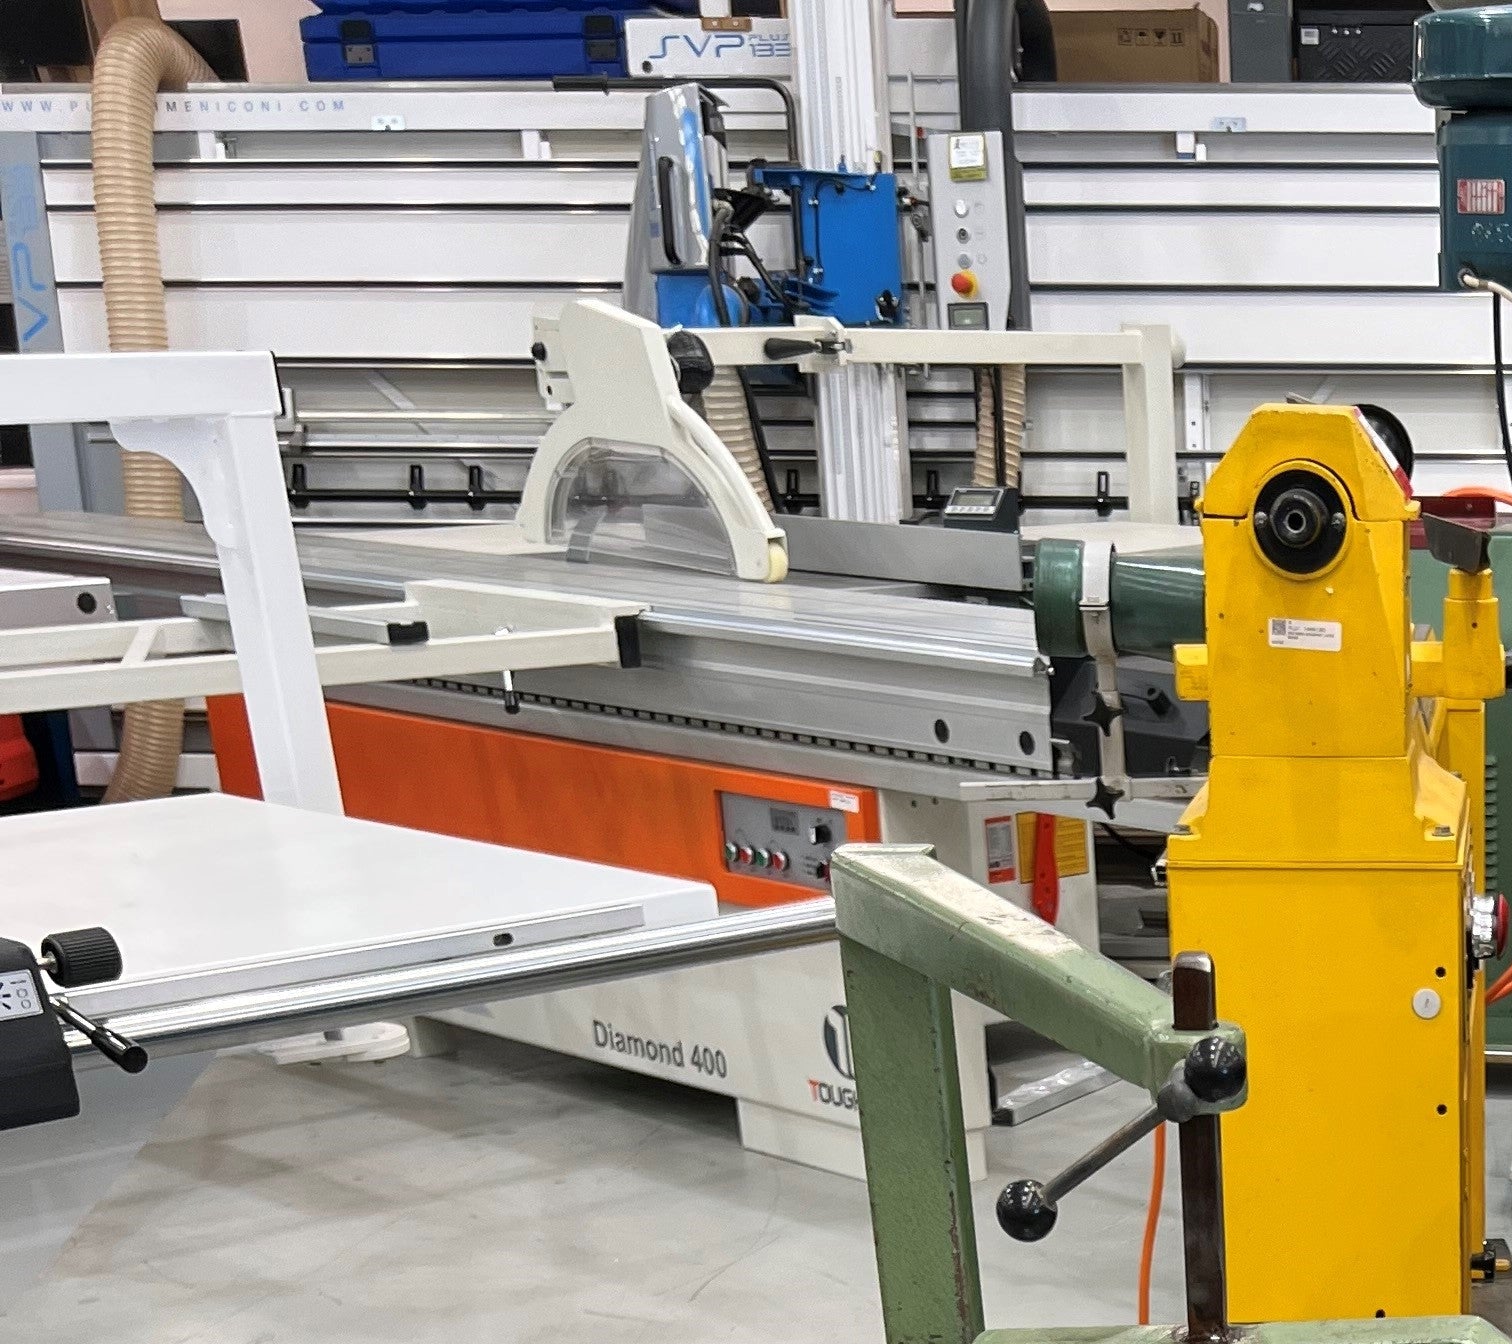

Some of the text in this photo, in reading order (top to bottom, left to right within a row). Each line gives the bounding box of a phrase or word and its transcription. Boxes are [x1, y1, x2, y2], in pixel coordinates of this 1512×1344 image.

[648, 34, 745, 59] SVP
[593, 1019, 728, 1079] Diamond 400
[808, 1078, 858, 1110] TOUG
